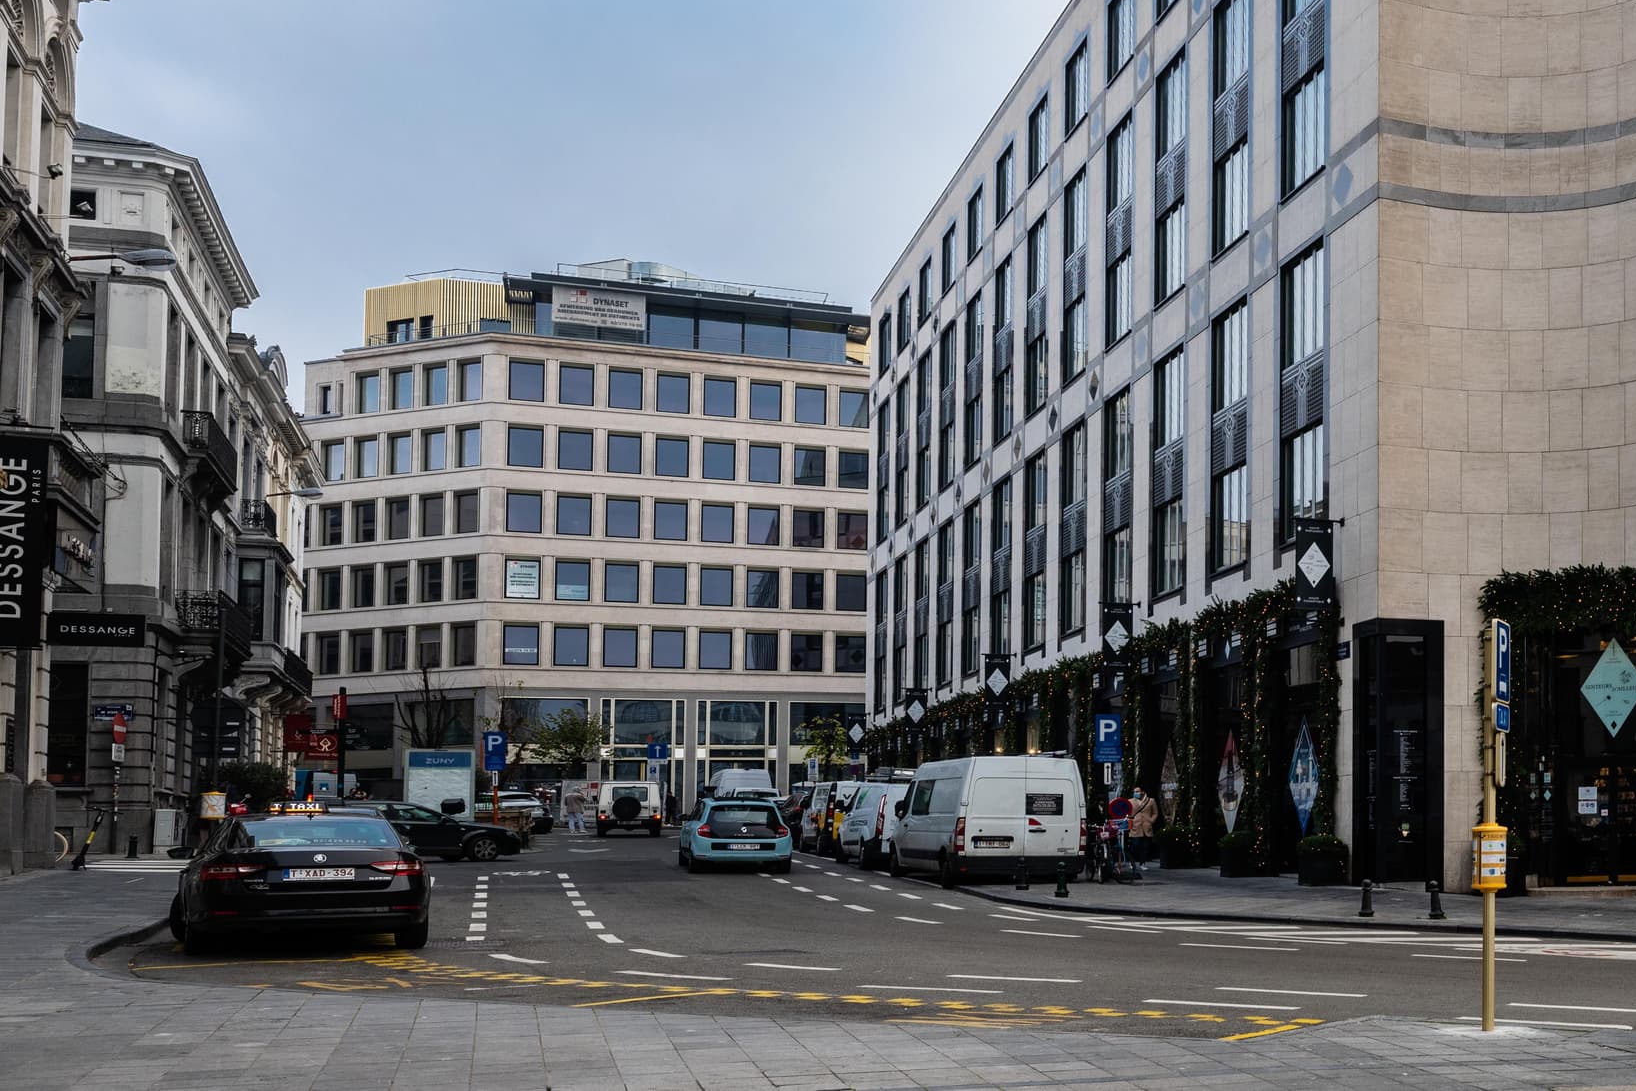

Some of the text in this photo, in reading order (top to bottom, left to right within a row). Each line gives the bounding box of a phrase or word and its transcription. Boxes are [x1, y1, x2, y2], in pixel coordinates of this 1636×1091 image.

[593, 297, 629, 308] DYNASET
[31, 469, 42, 503] PARIS
[60, 624, 136, 635] DESSANGE
[1499, 627, 1508, 669] P
[1099, 719, 1118, 742] P
[488, 735, 503, 752] P
